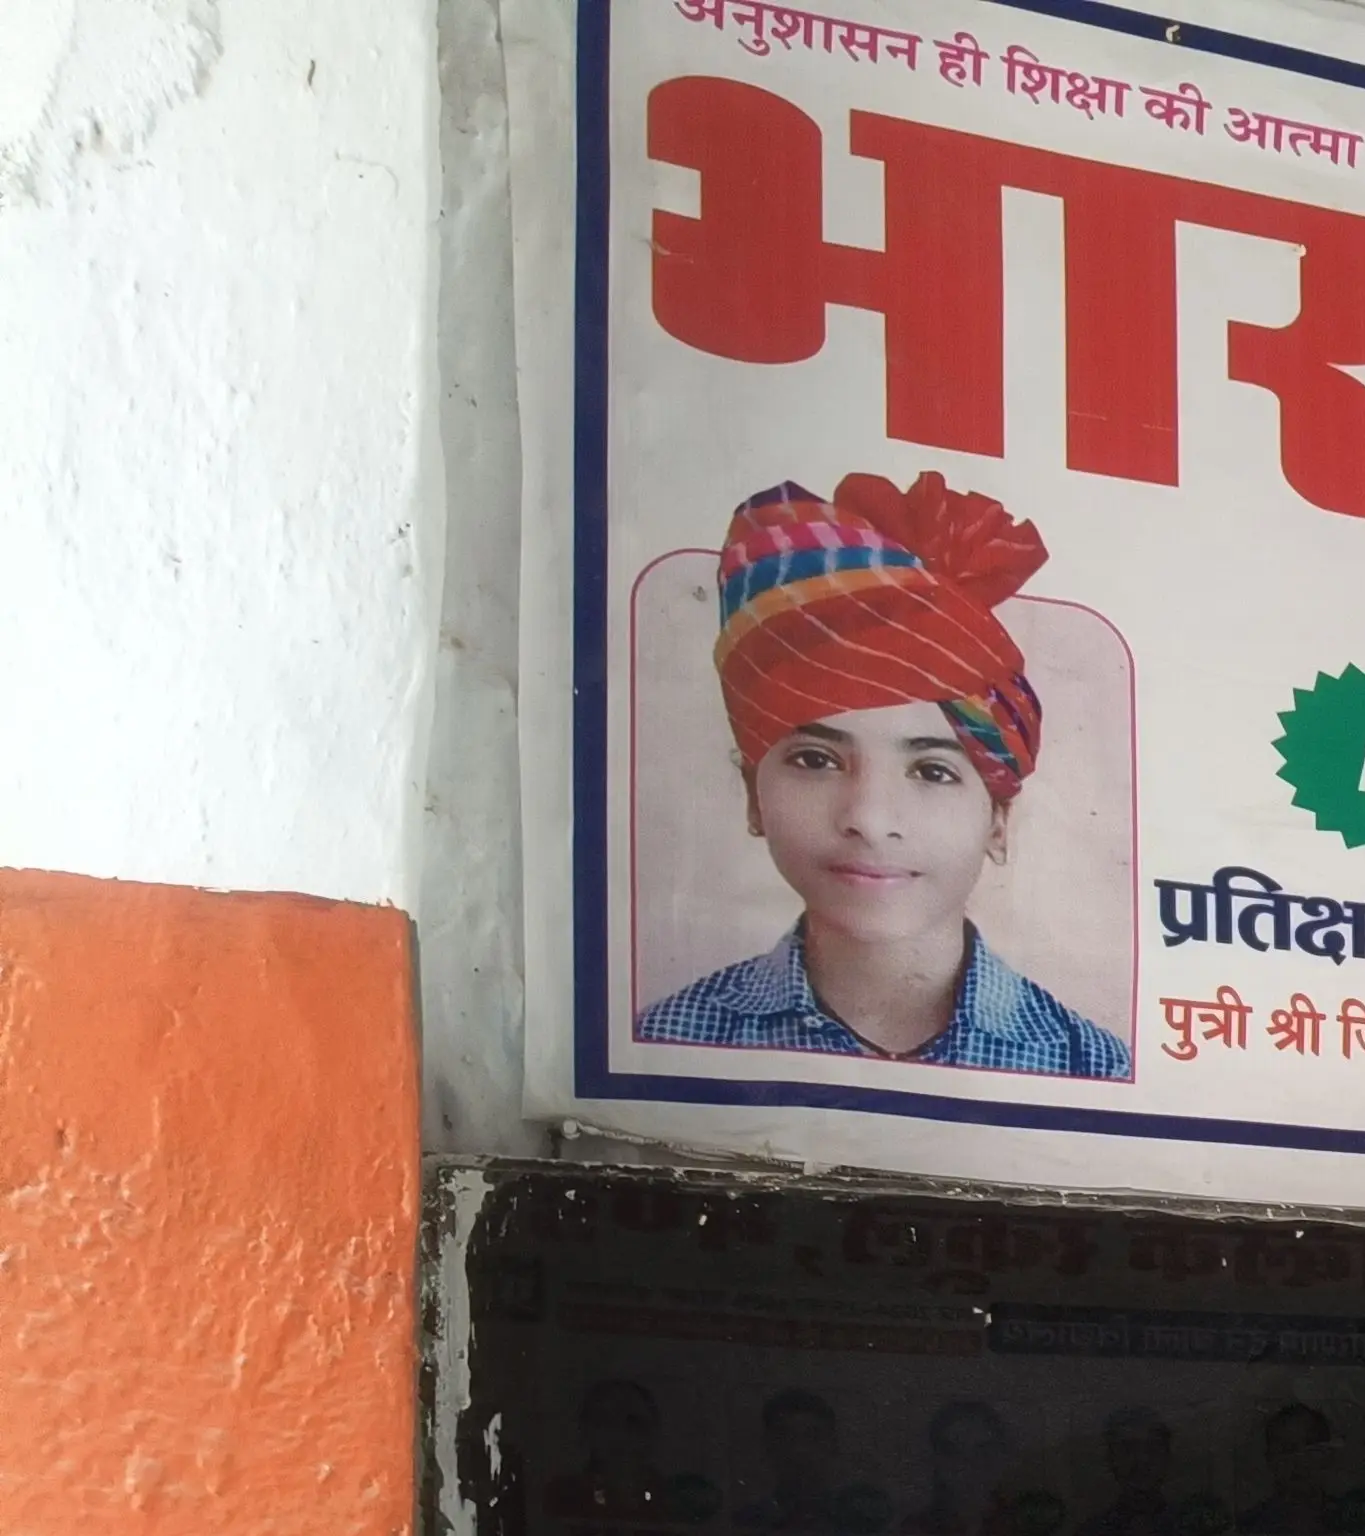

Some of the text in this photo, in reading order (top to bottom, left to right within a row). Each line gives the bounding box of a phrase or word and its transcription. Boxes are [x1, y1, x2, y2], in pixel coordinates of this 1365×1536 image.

[672, 0, 922, 72] अनुशासन
[933, 33, 990, 88] ही
[1000, 44, 1130, 121] शिक्षा
[1139, 83, 1211, 135] की
[1225, 107, 1362, 169] आत्मा
[1159, 985, 1253, 1061] पुत्री
[1265, 993, 1326, 1057] श्री
